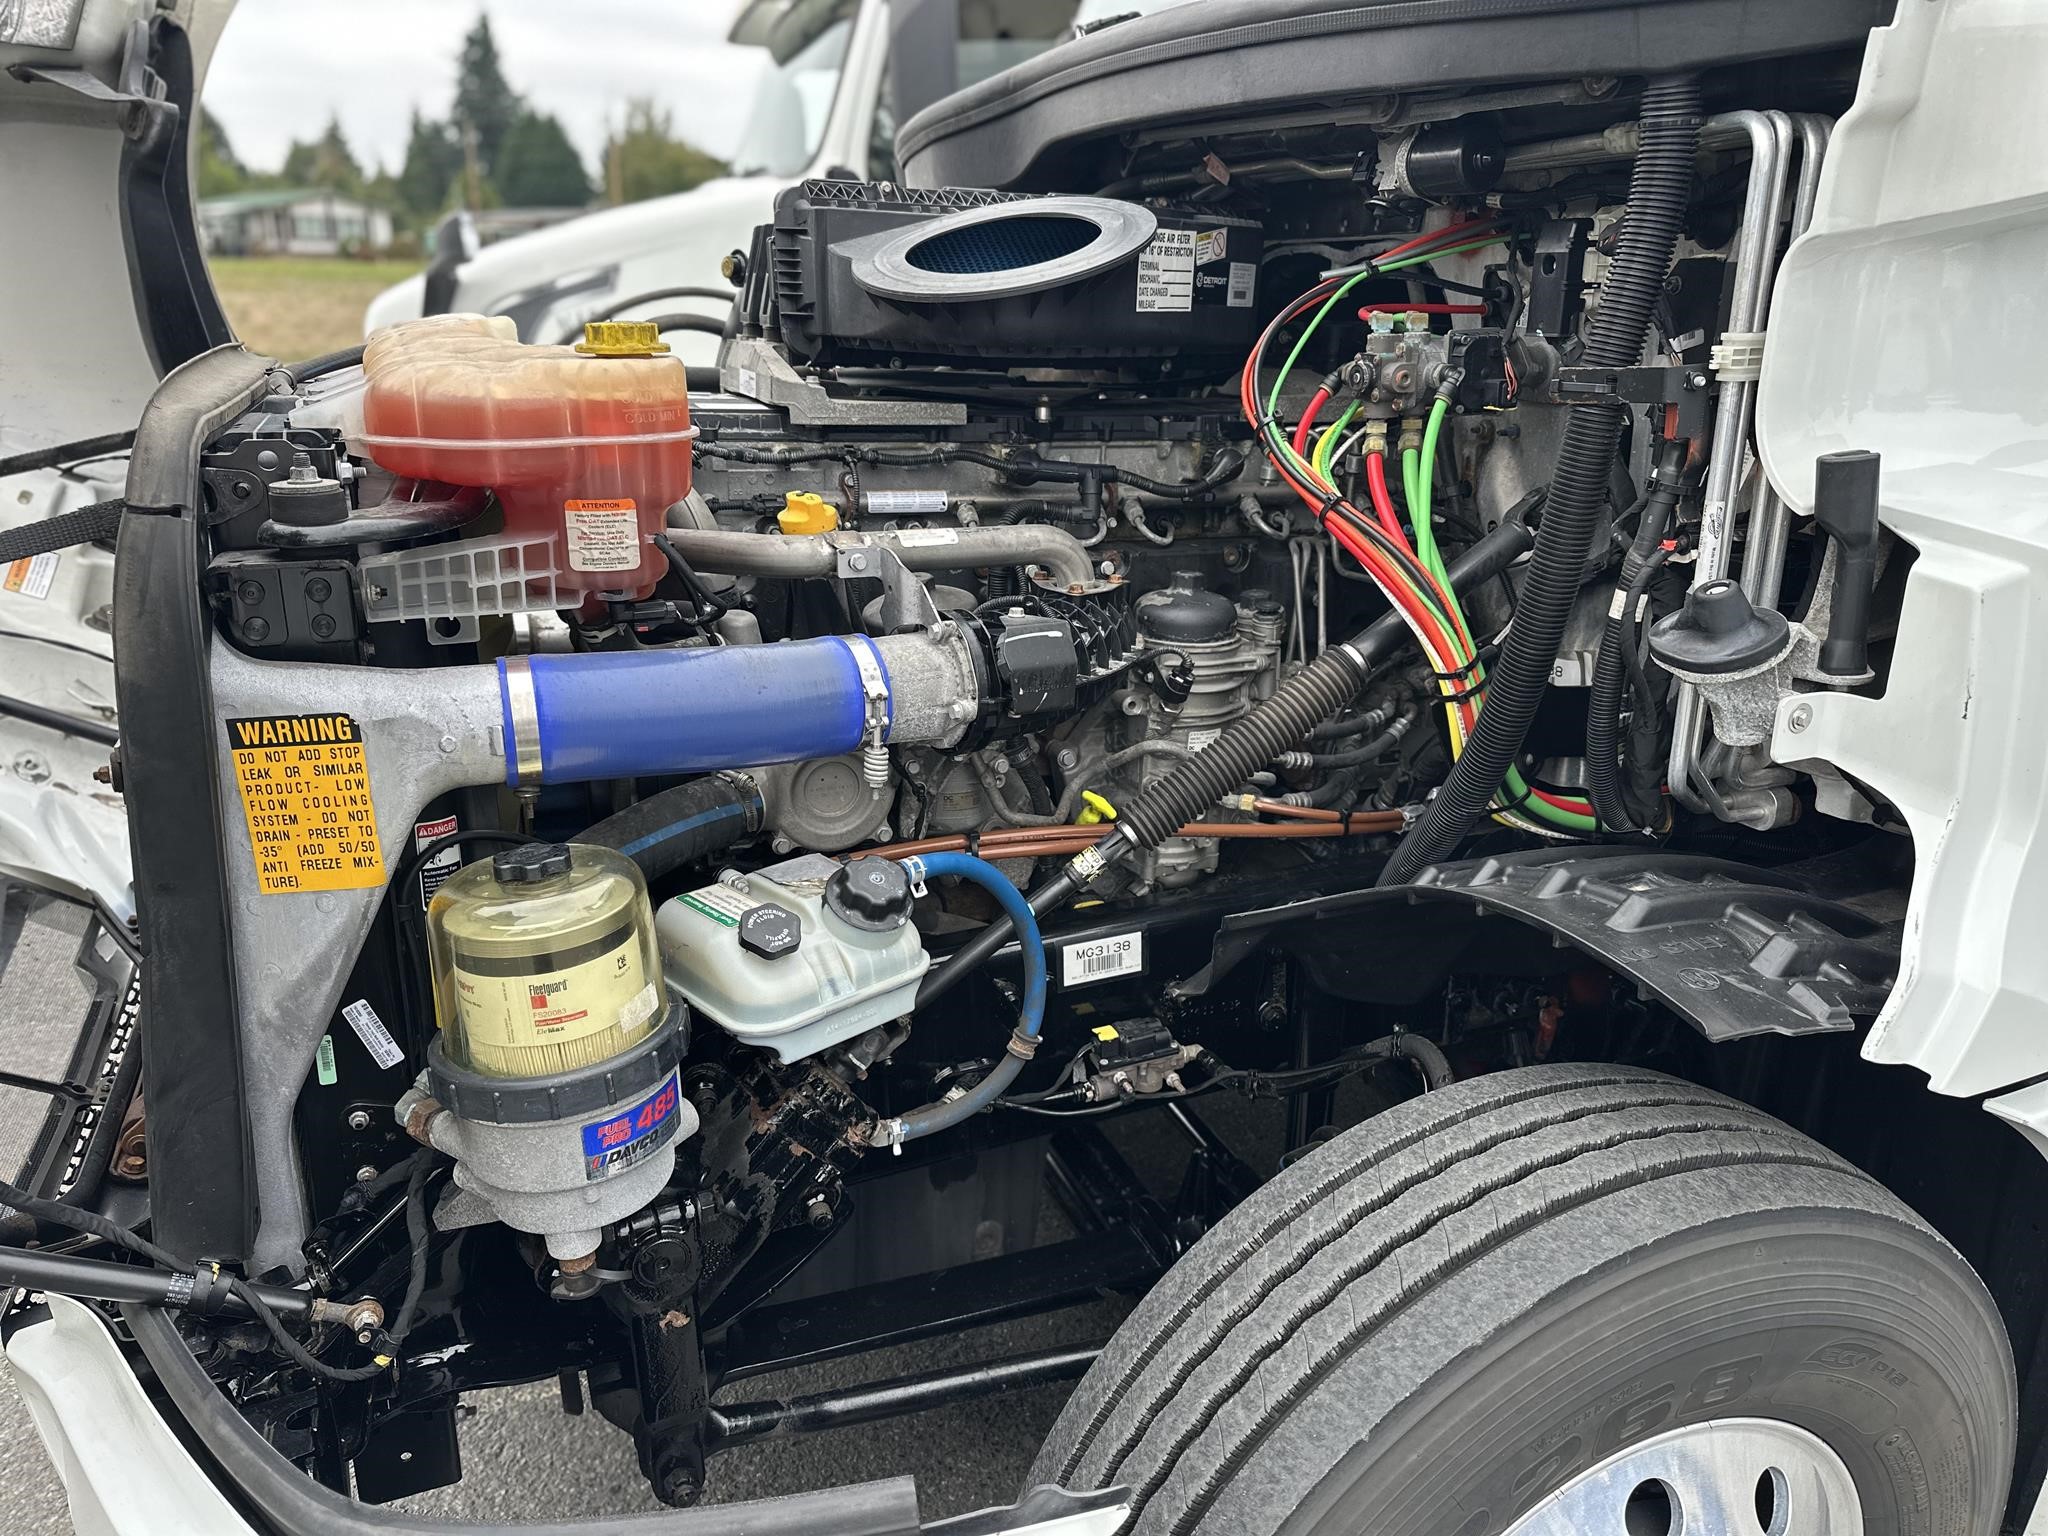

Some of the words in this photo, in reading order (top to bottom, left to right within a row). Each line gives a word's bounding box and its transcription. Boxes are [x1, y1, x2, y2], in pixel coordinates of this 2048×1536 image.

[1154, 232, 1166, 243] NGE
[1167, 233, 1176, 243] AIR
[1177, 234, 1190, 245] FILTER
[1157, 246, 1163, 256] OF
[1164, 246, 1194, 257] RESTRICTION
[1140, 261, 1160, 271] TERMINAL
[1140, 274, 1160, 284] MECHANIC
[1203, 276, 1227, 285] DETROIT
[1139, 287, 1149, 297] DATE
[1149, 287, 1168, 297] CHANGED
[1139, 300, 1156, 309] MILEAGE
[236, 716, 353, 745] WARNING
[239, 752, 255, 764] DO
[265, 750, 287, 763] NOT
[298, 749, 321, 761] ADD
[330, 746, 360, 759] STOP
[242, 767, 272, 780] LEAK
[284, 766, 300, 778] OR
[313, 762, 363, 776] SIMILAR
[246, 781, 319, 796] PRODUCT-
[335, 778, 365, 791] LOW
[250, 798, 288, 811] FLOW
[303, 794, 368, 809] COOLING
[253, 814, 299, 827] SYSTEM
[322, 811, 338, 823] DO
[348, 810, 370, 822] NOT
[256, 830, 291, 842] DRAIN
[308, 826, 350, 840] PRESET
[358, 825, 373, 837] TO
[427, 821, 456, 835] DANGER
[297, 843, 325, 857] (ADD
[339, 840, 375, 853] 50/50
[263, 860, 289, 873] ANTI
[300, 858, 342, 871] FREEZE
[352, 856, 379, 868] MIX-
[424, 868, 449, 876] Automatic
[747, 913, 759, 929] POWER
[758, 909, 787, 919] STEERING
[756, 914, 775, 924] FLUID
[1076, 940, 1131, 960] MG3138
[529, 979, 568, 997] Fleetguard
[637, 1083, 675, 1130] 485
[597, 1118, 633, 1139] FUEL
[602, 1127, 633, 1149] PRO
[607, 1128, 659, 1165] DAVCO
